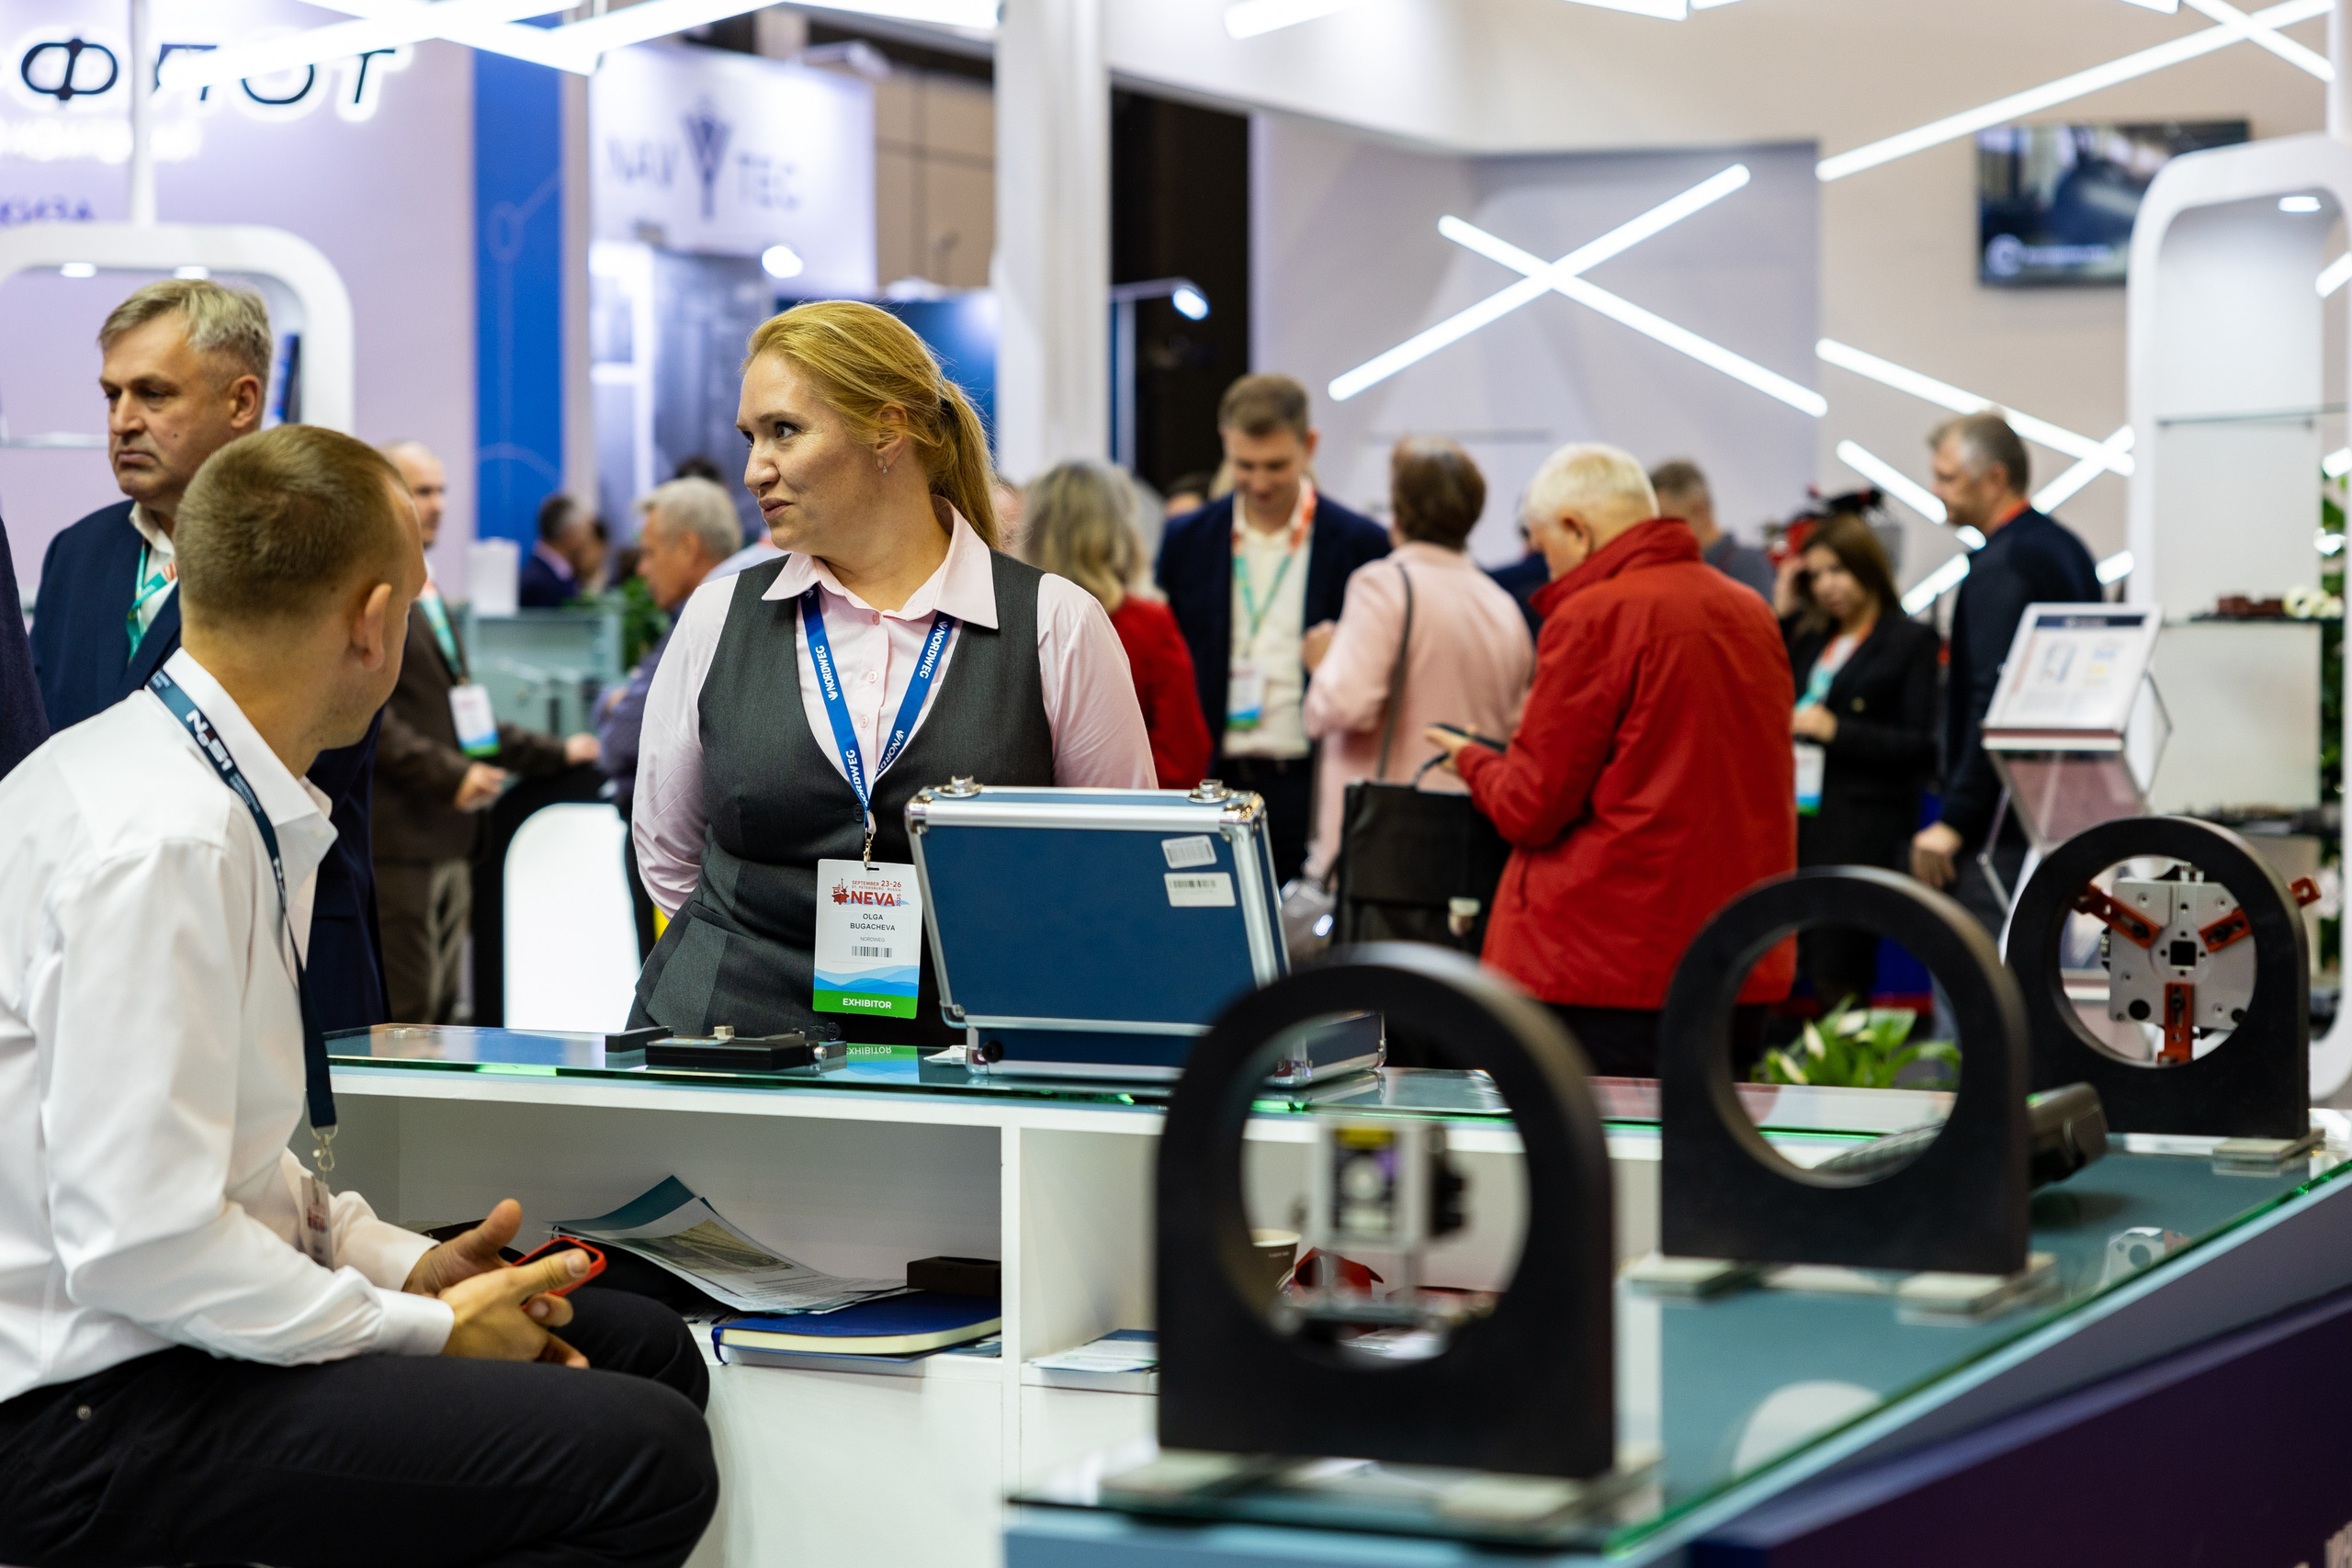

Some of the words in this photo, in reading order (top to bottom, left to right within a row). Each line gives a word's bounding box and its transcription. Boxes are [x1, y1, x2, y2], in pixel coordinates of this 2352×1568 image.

[815, 645, 836, 692] NORDWEG
[919, 628, 945, 679] NORDWEG
[876, 739, 901, 773] NORD
[851, 890, 896, 907] NEVA
[842, 998, 892, 1009] EXHIBITOR
